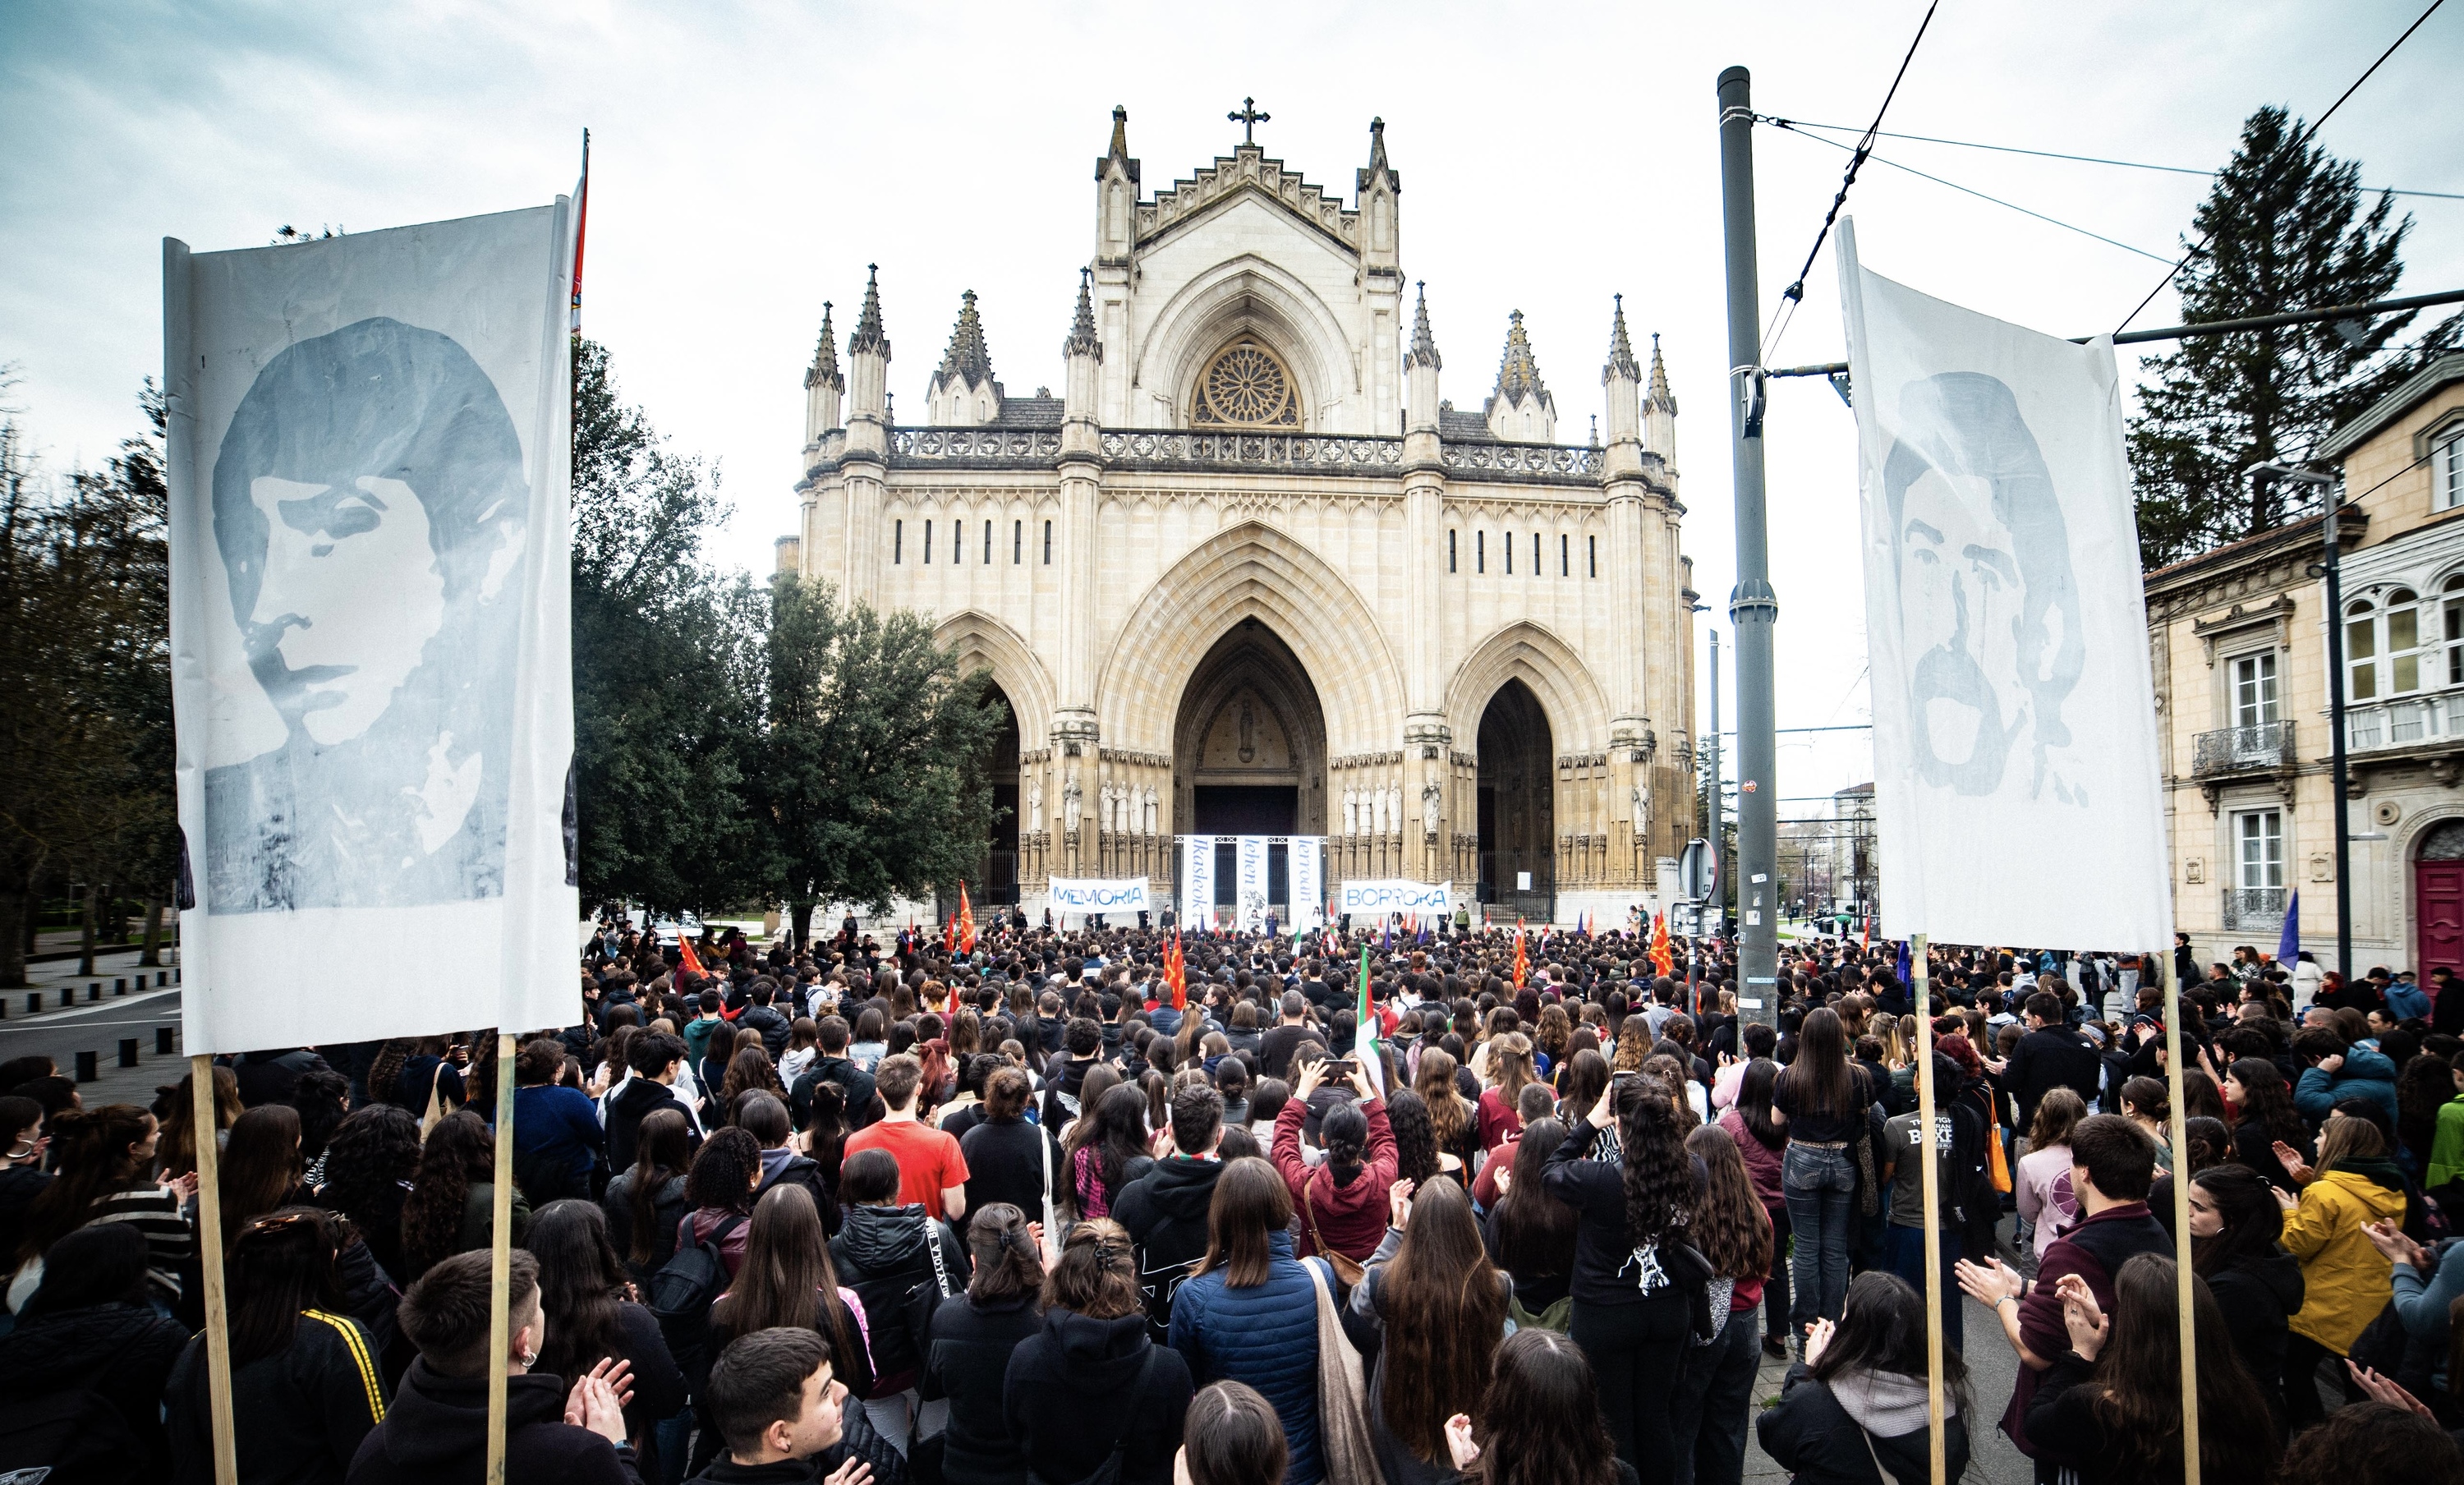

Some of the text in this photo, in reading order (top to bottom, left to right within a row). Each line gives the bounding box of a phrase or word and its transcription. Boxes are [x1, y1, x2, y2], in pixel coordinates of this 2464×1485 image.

[1193, 838, 1209, 909] Ikasleok
[1244, 839, 1260, 884] lehen
[1298, 839, 1313, 902] lerroan
[1053, 886, 1144, 905] MEMORIA
[1347, 888, 1446, 907] BORROKA
[1907, 1129, 1952, 1145] BXE
